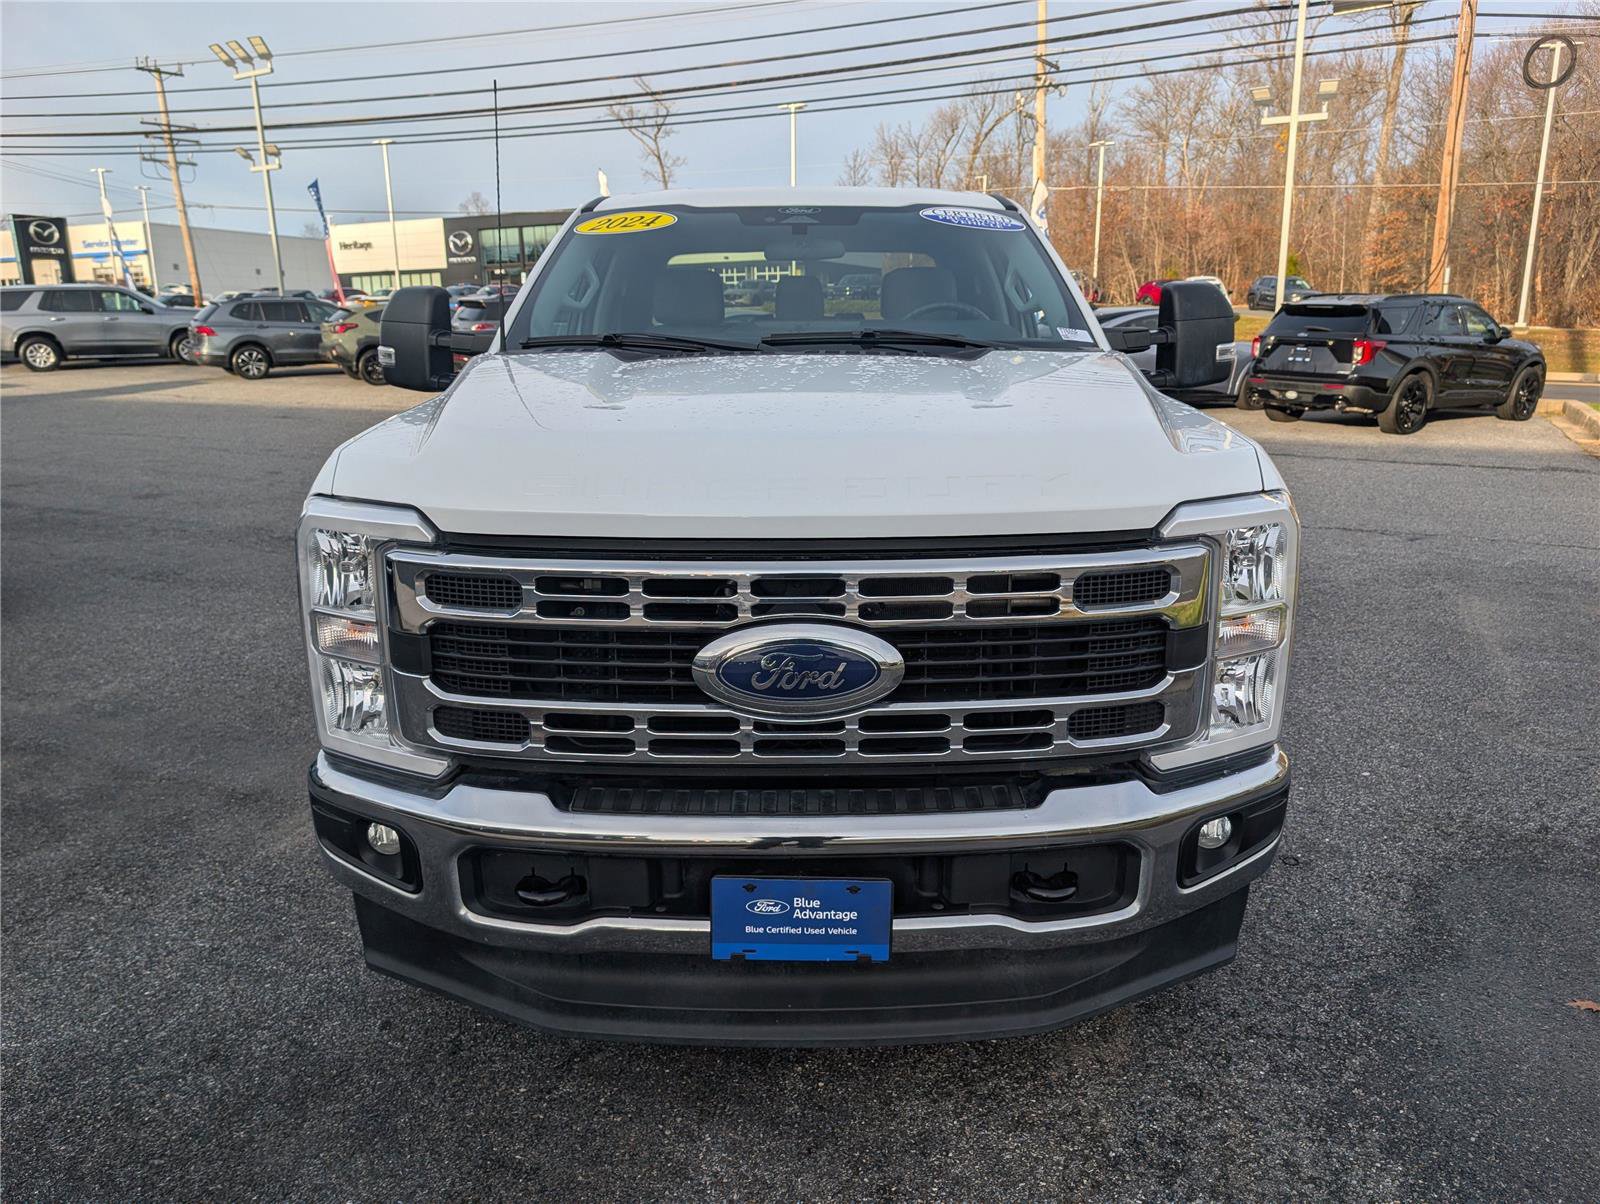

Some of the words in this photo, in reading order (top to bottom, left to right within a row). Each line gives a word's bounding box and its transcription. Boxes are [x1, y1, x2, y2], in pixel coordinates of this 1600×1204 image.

[588, 215, 663, 231] 2024
[339, 241, 373, 251] Heritage
[751, 652, 848, 691] Ford
[754, 900, 782, 914] Ford
[793, 898, 821, 908] Blue
[792, 909, 858, 922] Advantage
[745, 925, 764, 934] Blue
[766, 926, 802, 935] Certified
[804, 926, 826, 935] Used
[828, 926, 858, 935] Vehicle
